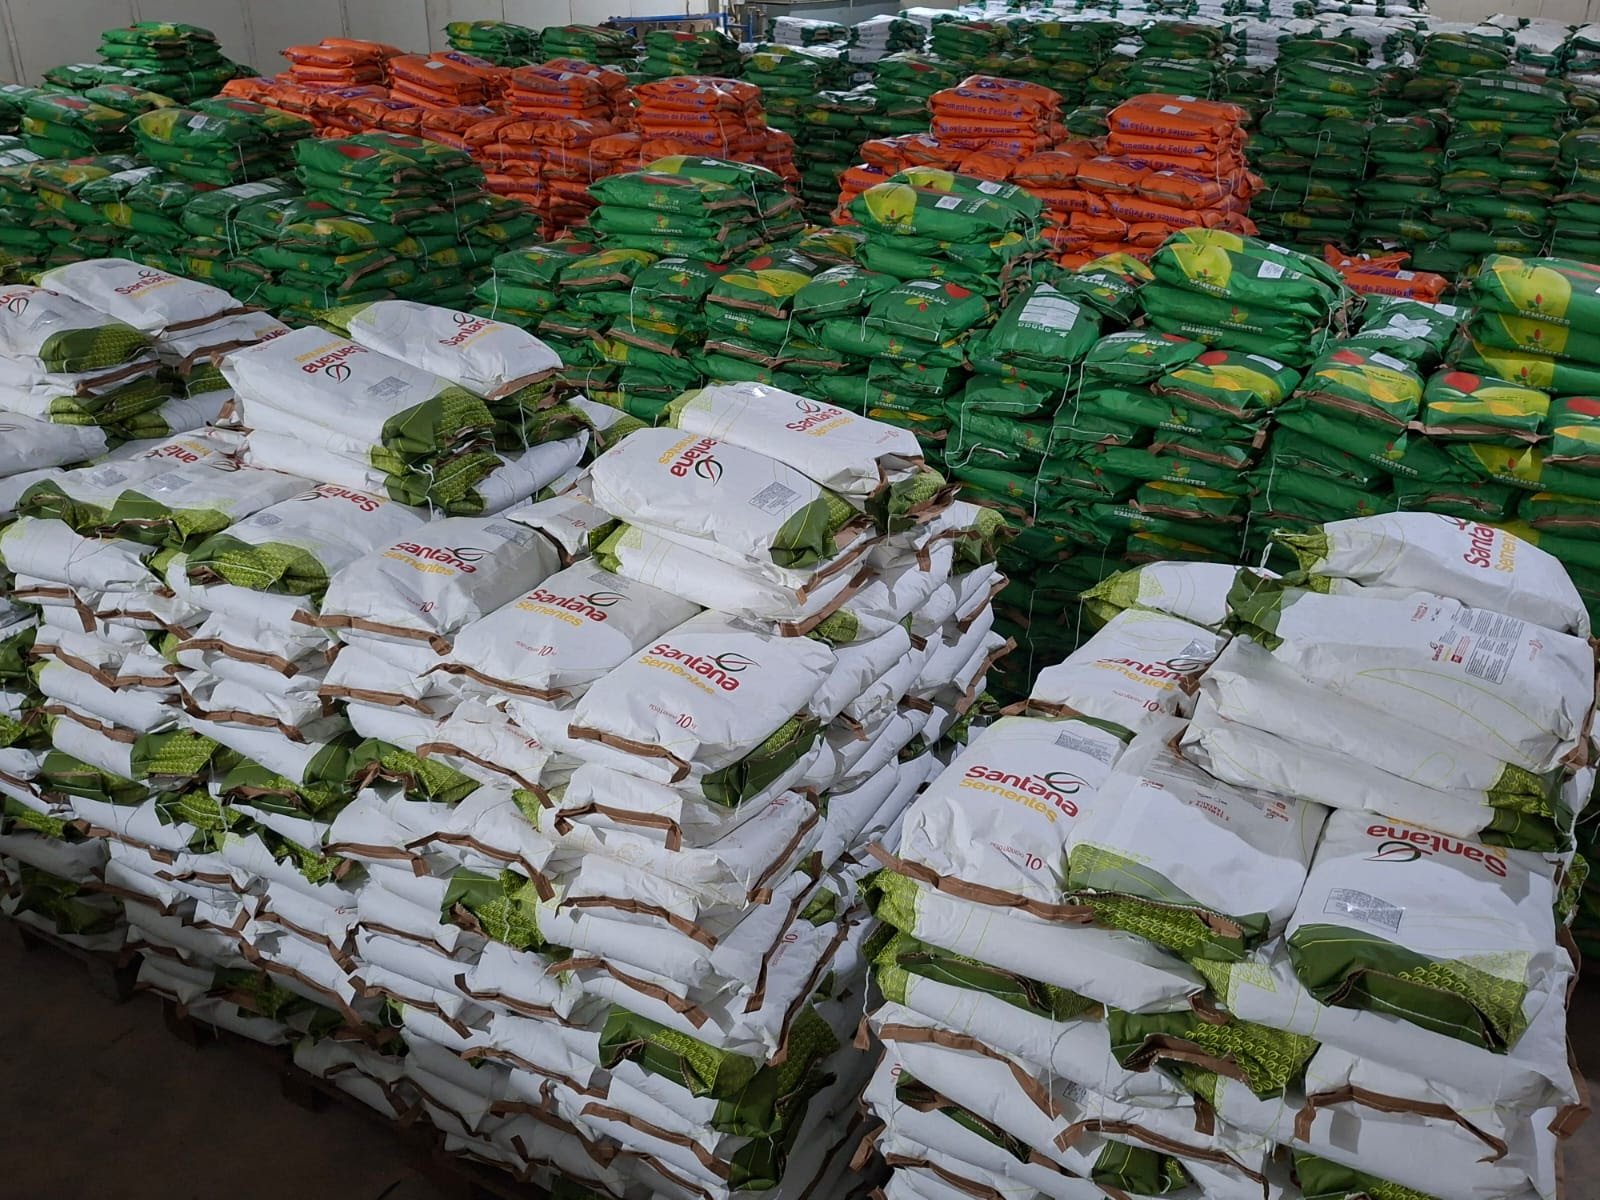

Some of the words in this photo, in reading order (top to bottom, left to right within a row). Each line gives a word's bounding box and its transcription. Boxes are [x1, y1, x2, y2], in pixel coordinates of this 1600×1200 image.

[989, 107, 1012, 117] Feijão
[949, 126, 972, 134] Feijão
[1130, 122, 1154, 133] Feijão
[1156, 126, 1166, 134] de
[1168, 144, 1195, 155] Feijão
[1189, 278, 1232, 296] SEMENTES
[1519, 310, 1571, 326] SEMENTES
[1181, 325, 1224, 338] SEMENTES
[1219, 320, 1263, 334] SEMENTES
[785, 408, 843, 432] Santana
[1159, 420, 1202, 434] SEMENTES
[670, 437, 718, 479] antana
[1369, 453, 1419, 477] SEMENTES
[1162, 474, 1208, 487] SEMENTES
[1491, 472, 1548, 490] SEMENTES
[389, 541, 478, 575] Santana
[420, 601, 434, 613] 10
[526, 588, 608, 622] Santana
[538, 645, 553, 657] 10
[648, 643, 740, 692] Santana
[1096, 657, 1183, 682] Santan
[1142, 699, 1160, 713] 10
[675, 713, 693, 729] 10
[964, 765, 1079, 818] Santana
[1366, 824, 1508, 878] Santana
[1025, 853, 1043, 871] 10
[783, 932, 799, 945] 10
